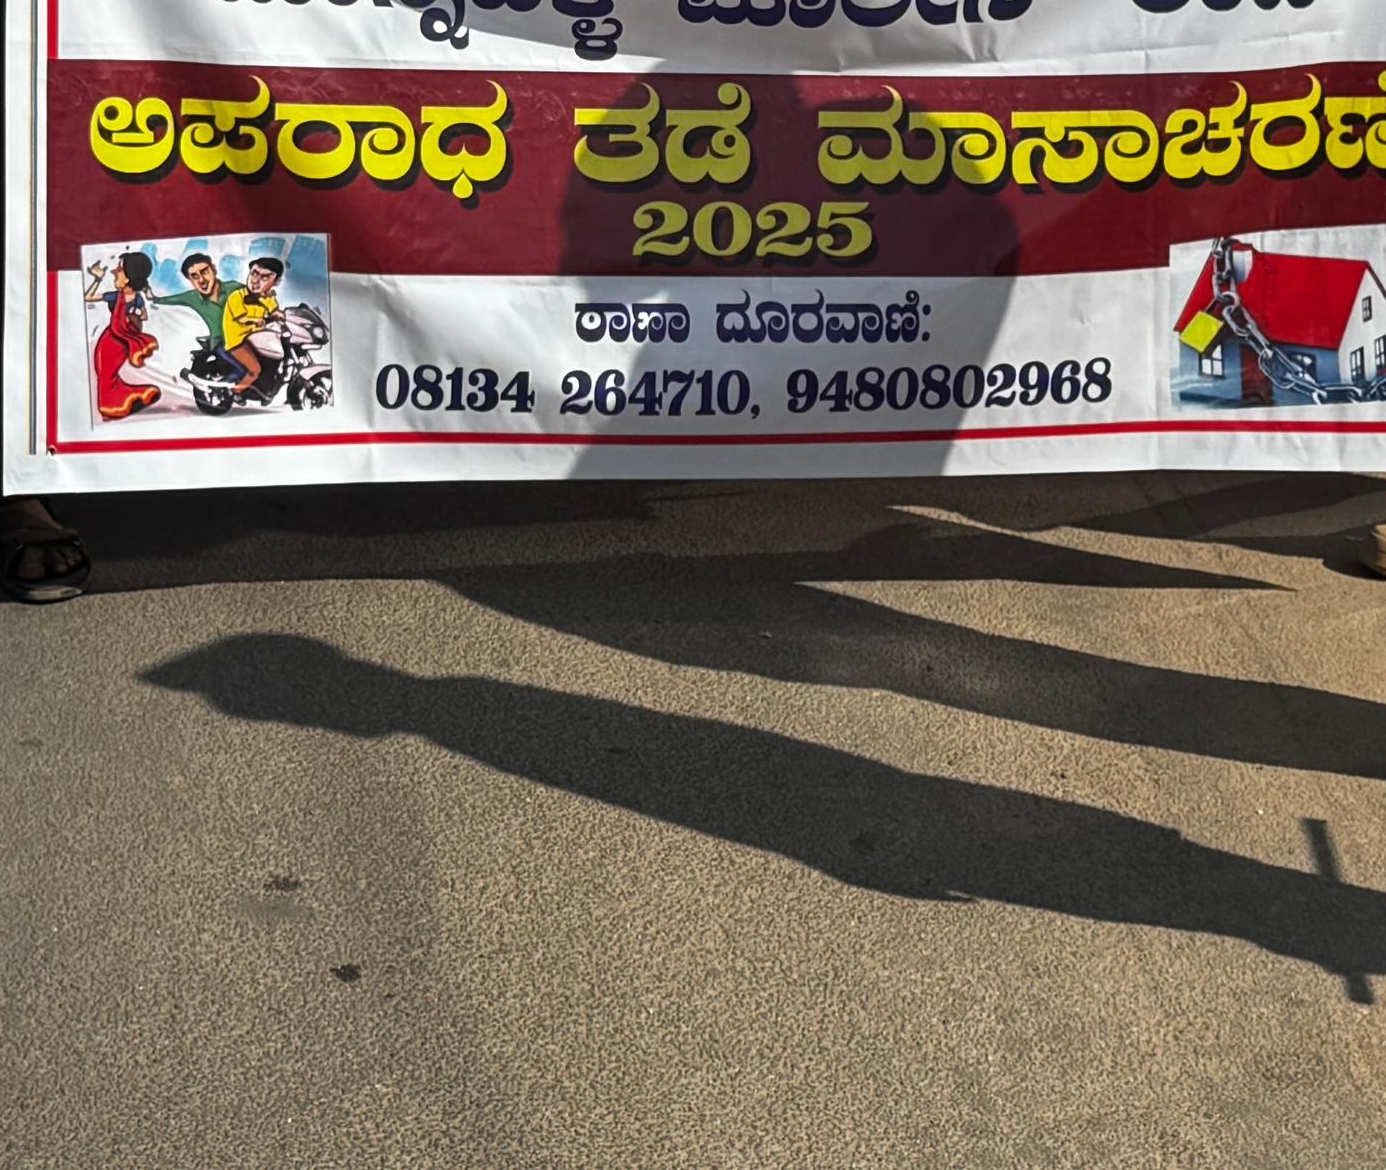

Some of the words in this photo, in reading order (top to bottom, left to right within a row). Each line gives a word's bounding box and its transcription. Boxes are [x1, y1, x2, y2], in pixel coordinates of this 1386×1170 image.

[87, 81, 513, 200] ಅಪರಾಧ
[572, 83, 756, 190] ತಡೆ
[628, 200, 874, 262] 2025
[573, 300, 692, 344] ಠಾಣಾ
[714, 289, 932, 344] ದೂರವಾಣಿ:
[376, 362, 537, 417] 08134
[558, 367, 762, 421] 264710,
[784, 356, 1114, 413] 9480802968
